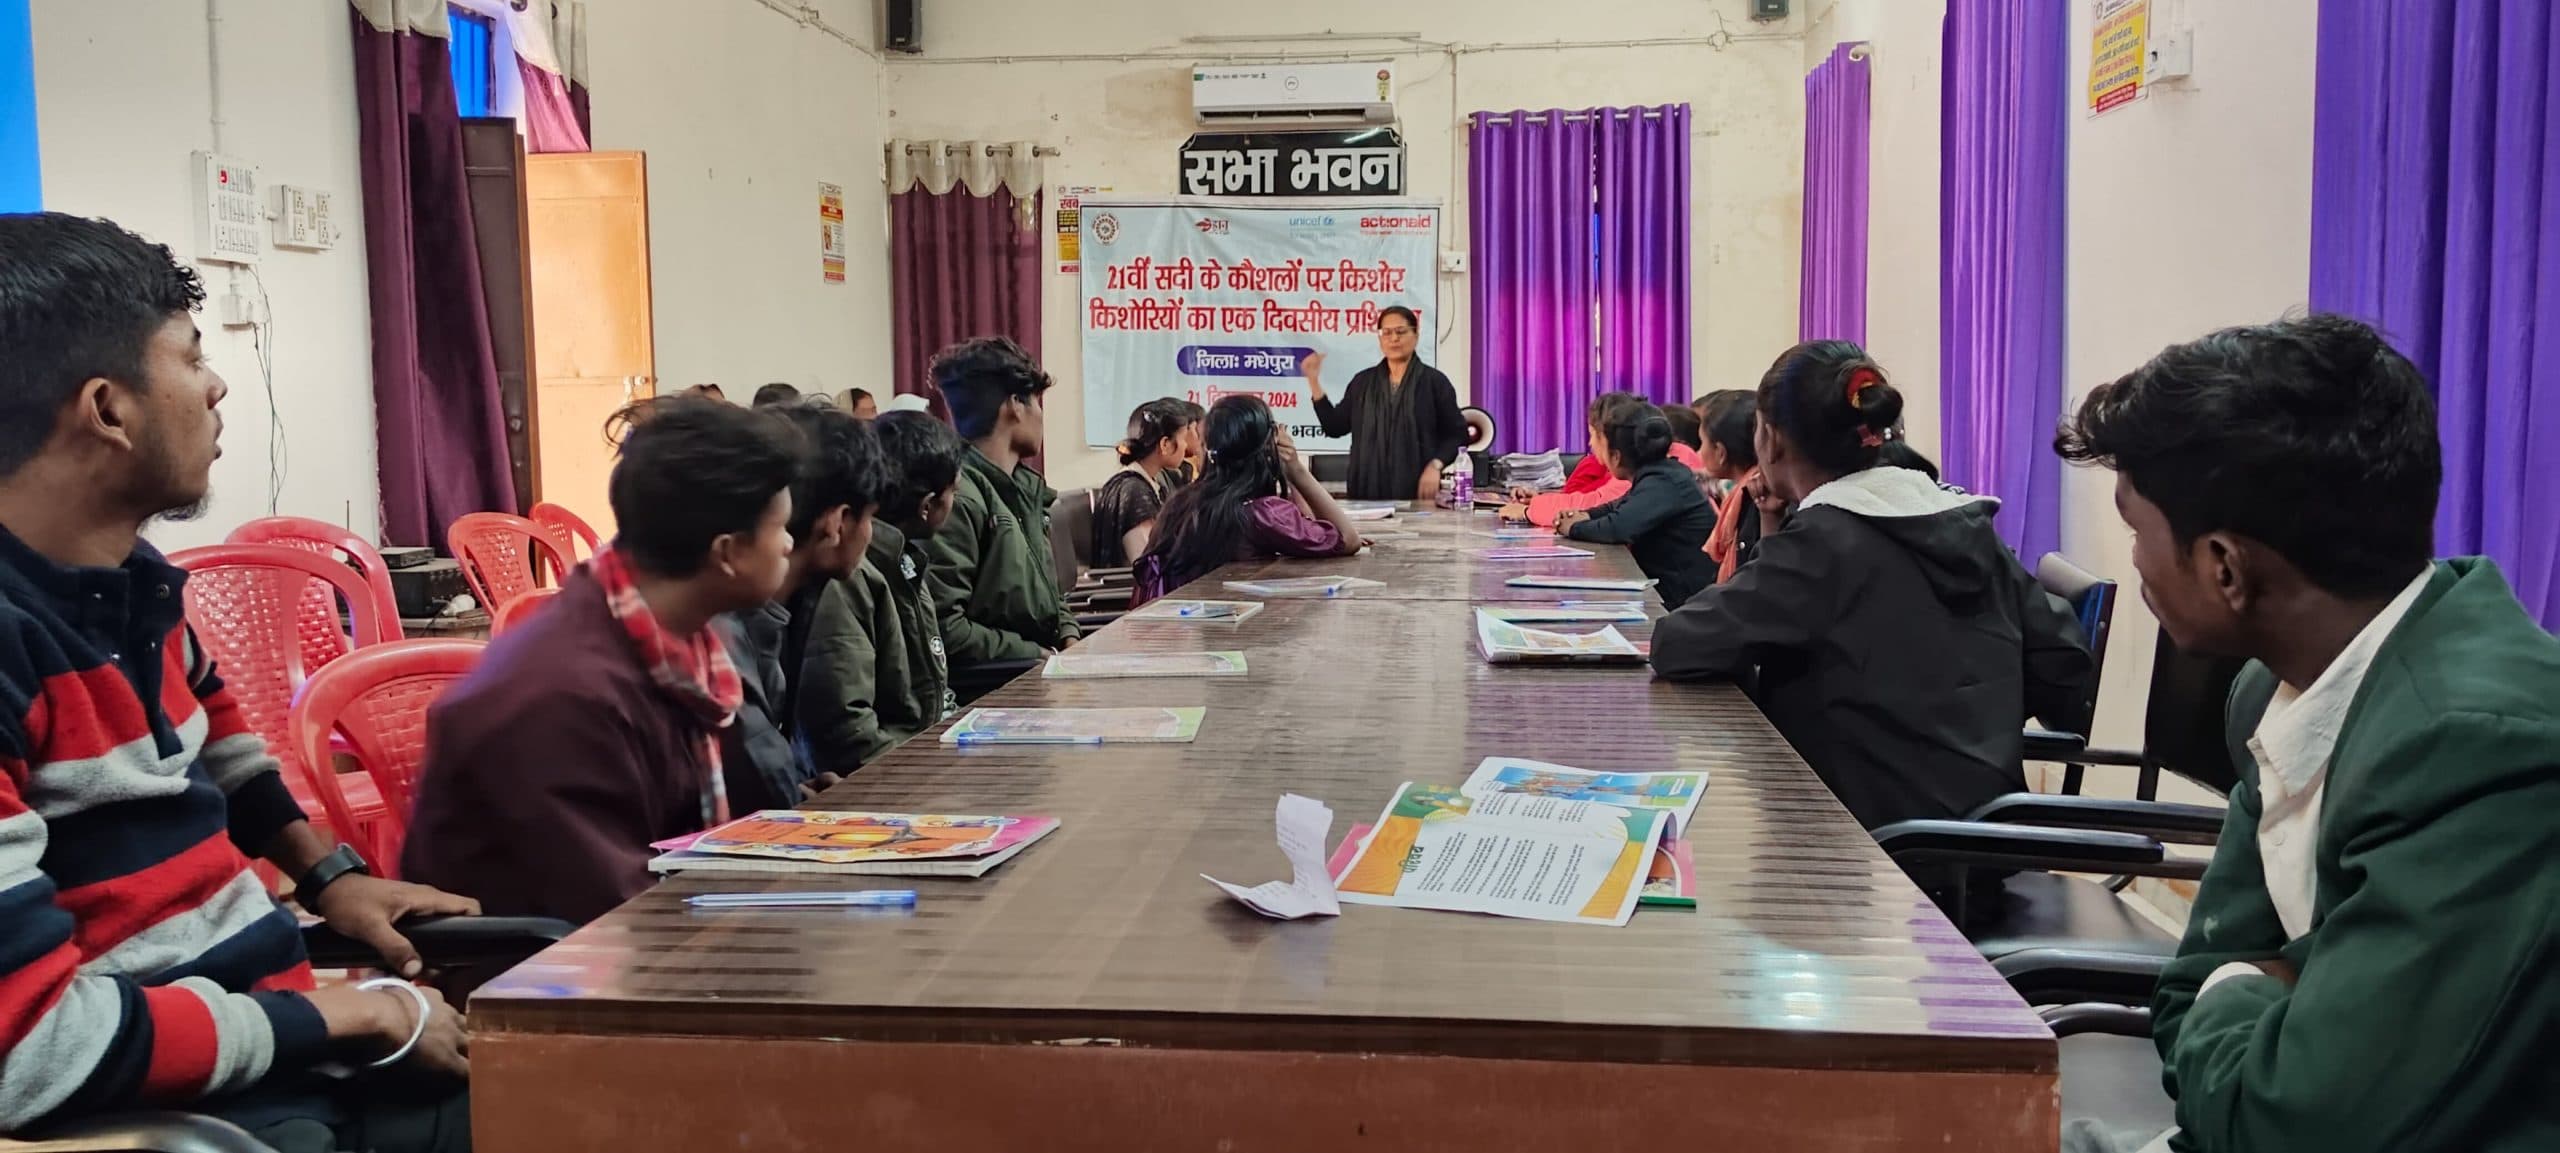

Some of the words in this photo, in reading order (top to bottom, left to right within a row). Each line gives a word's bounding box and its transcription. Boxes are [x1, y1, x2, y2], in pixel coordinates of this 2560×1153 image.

[1184, 148, 1278, 195] सभा
[1290, 147, 1401, 192] भवन
[1289, 215, 1321, 227] unicef
[1107, 256, 1151, 290] 21वीं
[1154, 257, 1195, 290] सदी
[1199, 258, 1222, 291] के
[1227, 258, 1302, 292] कौशलों
[1306, 268, 1334, 292] पर
[1338, 259, 1406, 293] किशोर
[1089, 297, 1184, 330] किशोरियों
[1187, 307, 1216, 331] का
[1221, 307, 1257, 333] एक
[1263, 299, 1340, 333] दिवसीय
[1244, 352, 1295, 375] मधेपुरा
[1268, 391, 1298, 408] 2024
